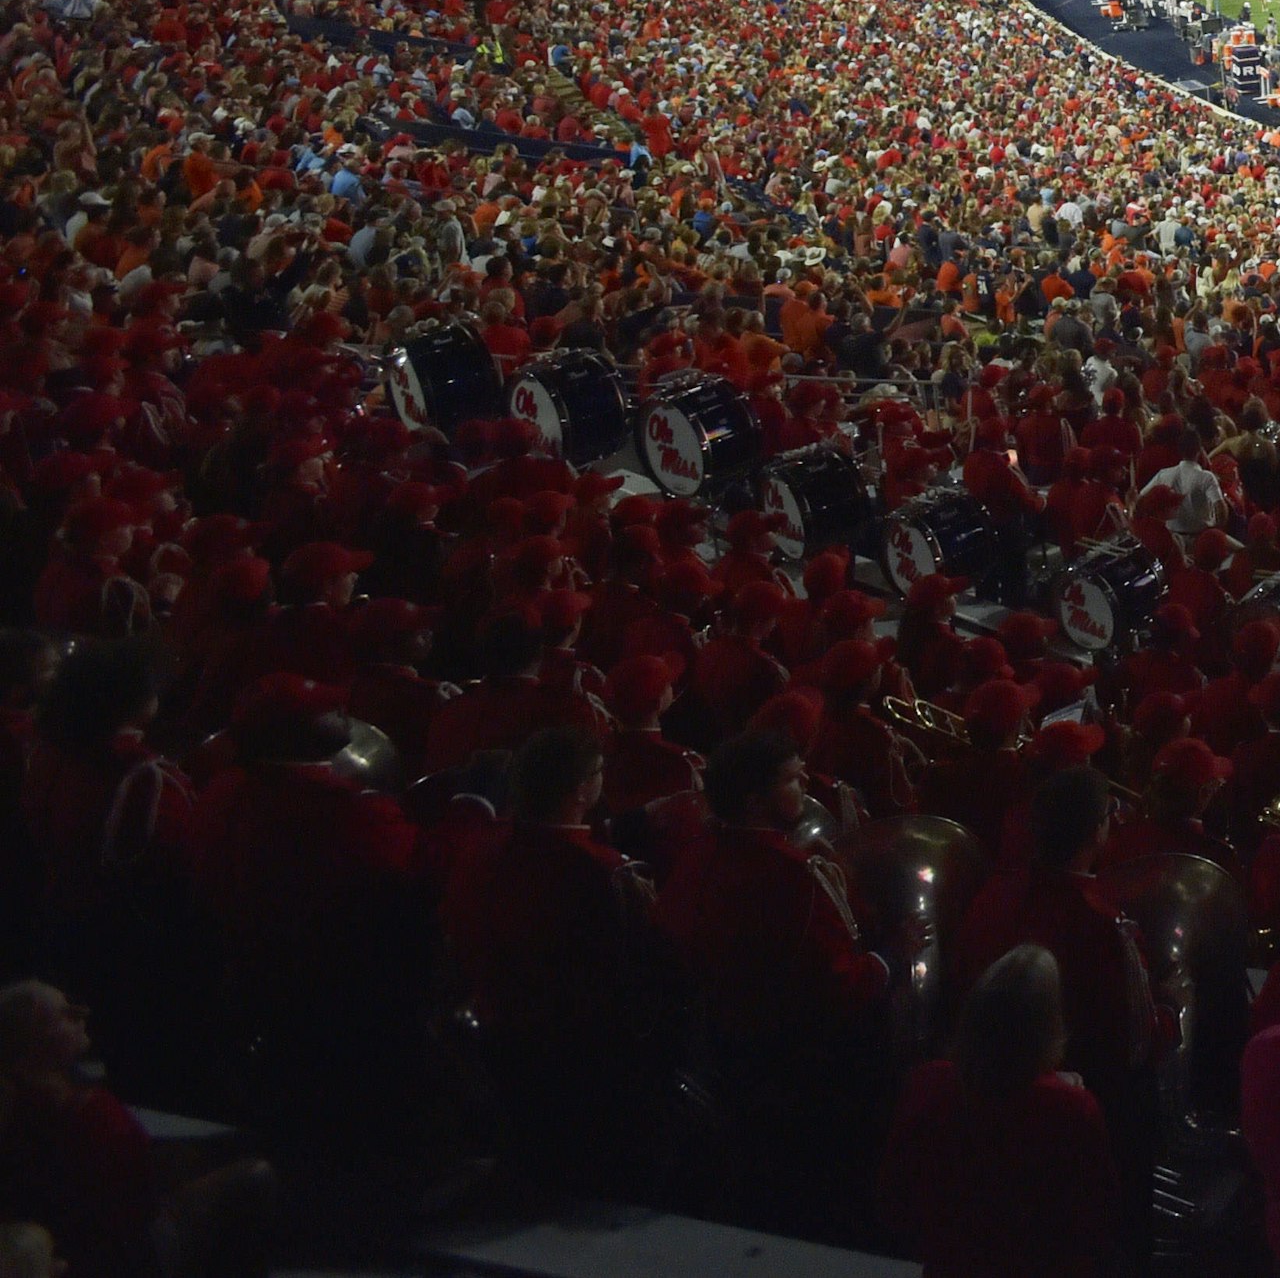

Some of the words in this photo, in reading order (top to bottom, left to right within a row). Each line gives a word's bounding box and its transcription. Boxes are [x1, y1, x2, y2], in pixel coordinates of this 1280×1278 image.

[516, 386, 538, 418] Ole
[649, 414, 674, 444] Ole
[657, 444, 699, 481] Miss
[764, 479, 784, 510] Ole
[892, 519, 913, 555] Ole
